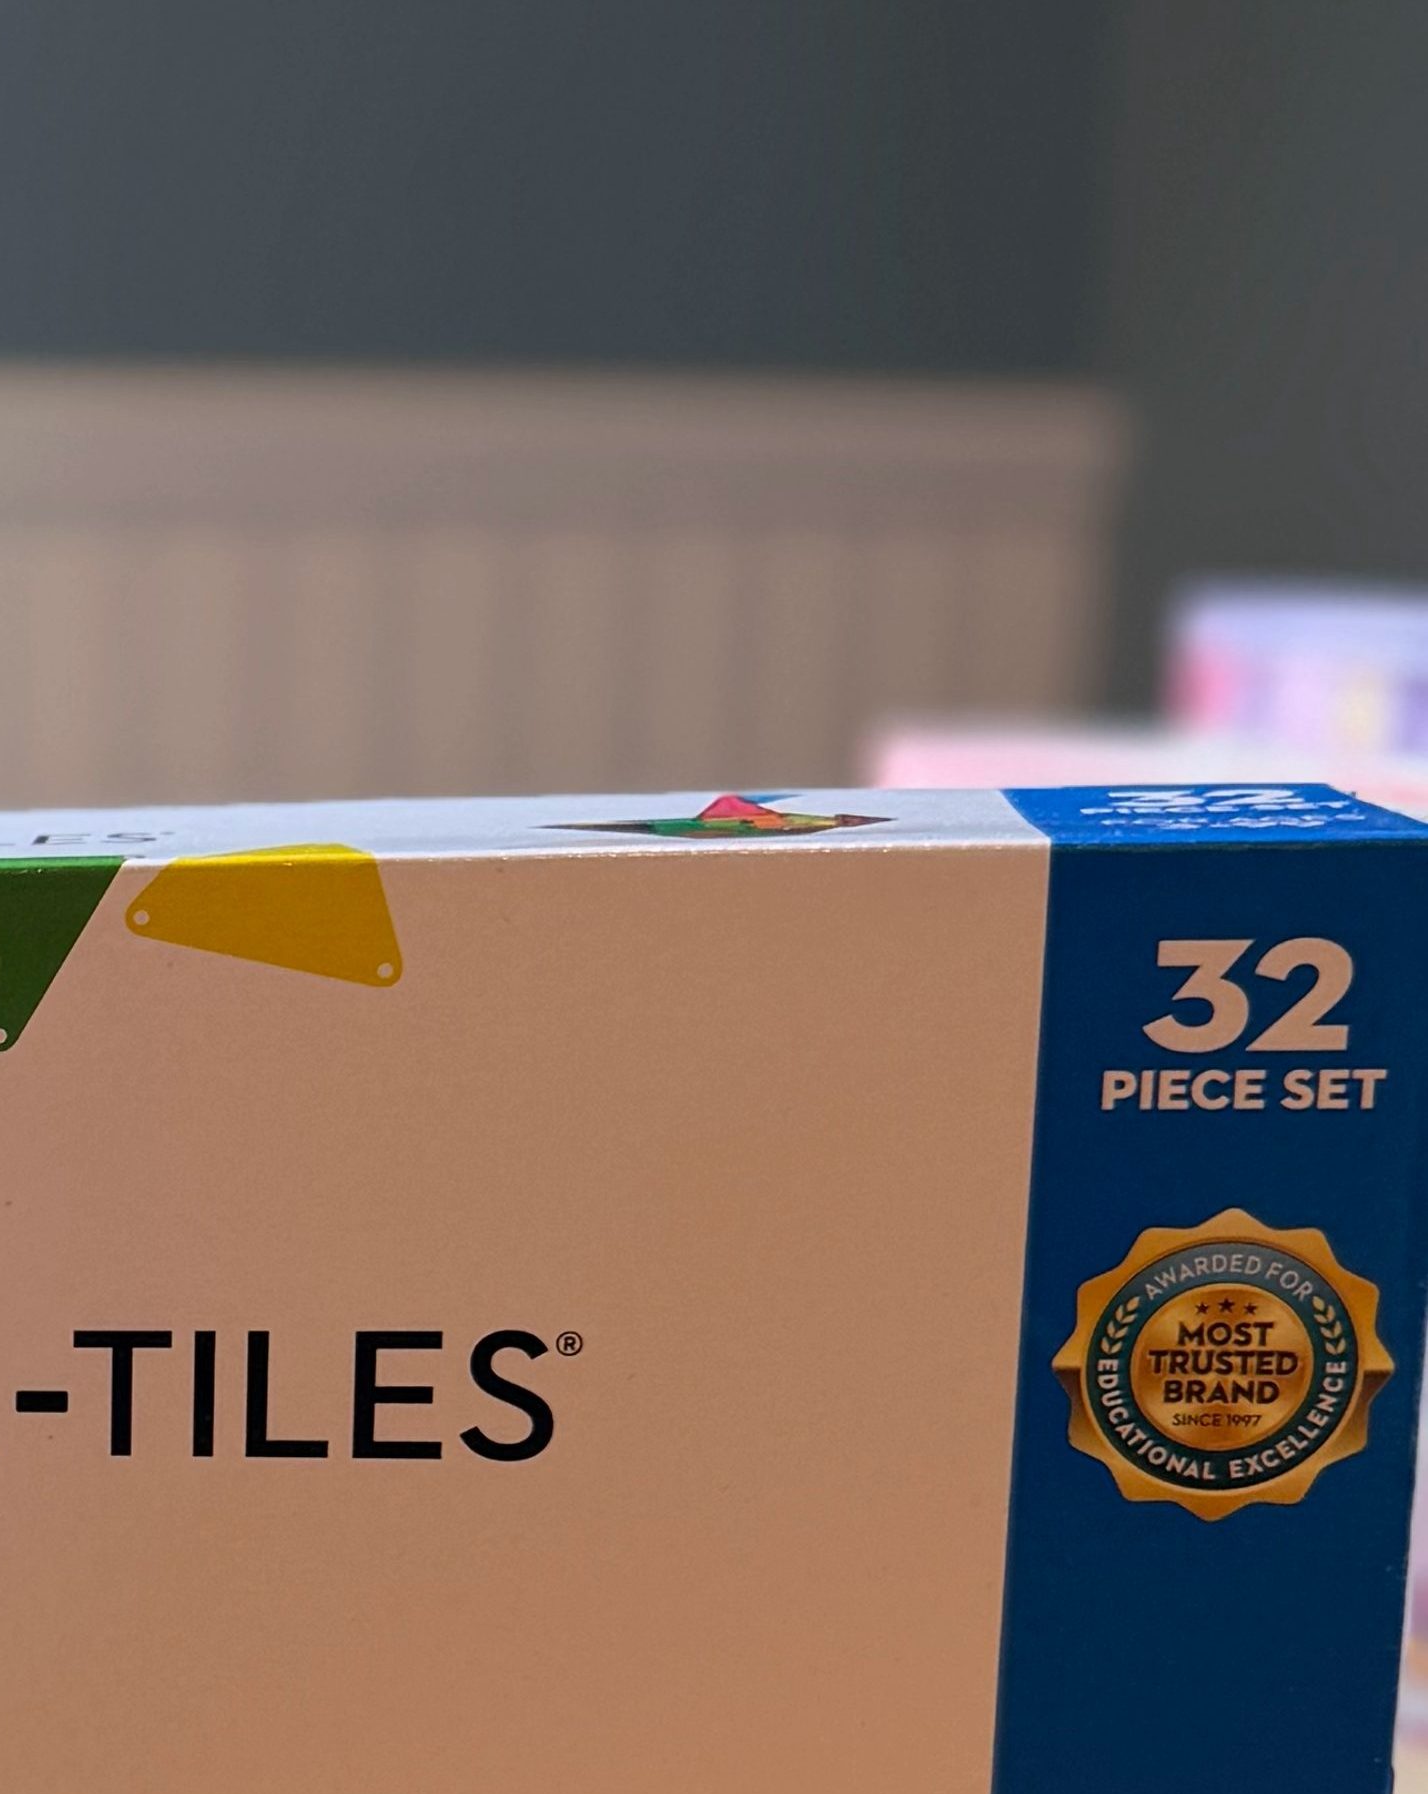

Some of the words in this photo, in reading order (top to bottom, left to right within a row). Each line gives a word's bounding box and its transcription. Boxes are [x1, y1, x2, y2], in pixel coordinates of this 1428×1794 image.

[1143, 937, 1353, 1053] 32
[1101, 1069, 1267, 1111] PIECE
[1280, 1069, 1387, 1110] SET
[1143, 1254, 1262, 1300] AWARDED
[1265, 1261, 1314, 1302] FOR
[1177, 1321, 1274, 1346] MOST
[1148, 1350, 1299, 1376] TRUSTED
[1163, 1380, 1280, 1404] BRAND
[1097, 1358, 1216, 1480] EDUCATIONAL
[1229, 1361, 1347, 1479] EXCELLENCE
[1172, 1413, 1222, 1427] SINCE
[1226, 1413, 1262, 1427] 1997
